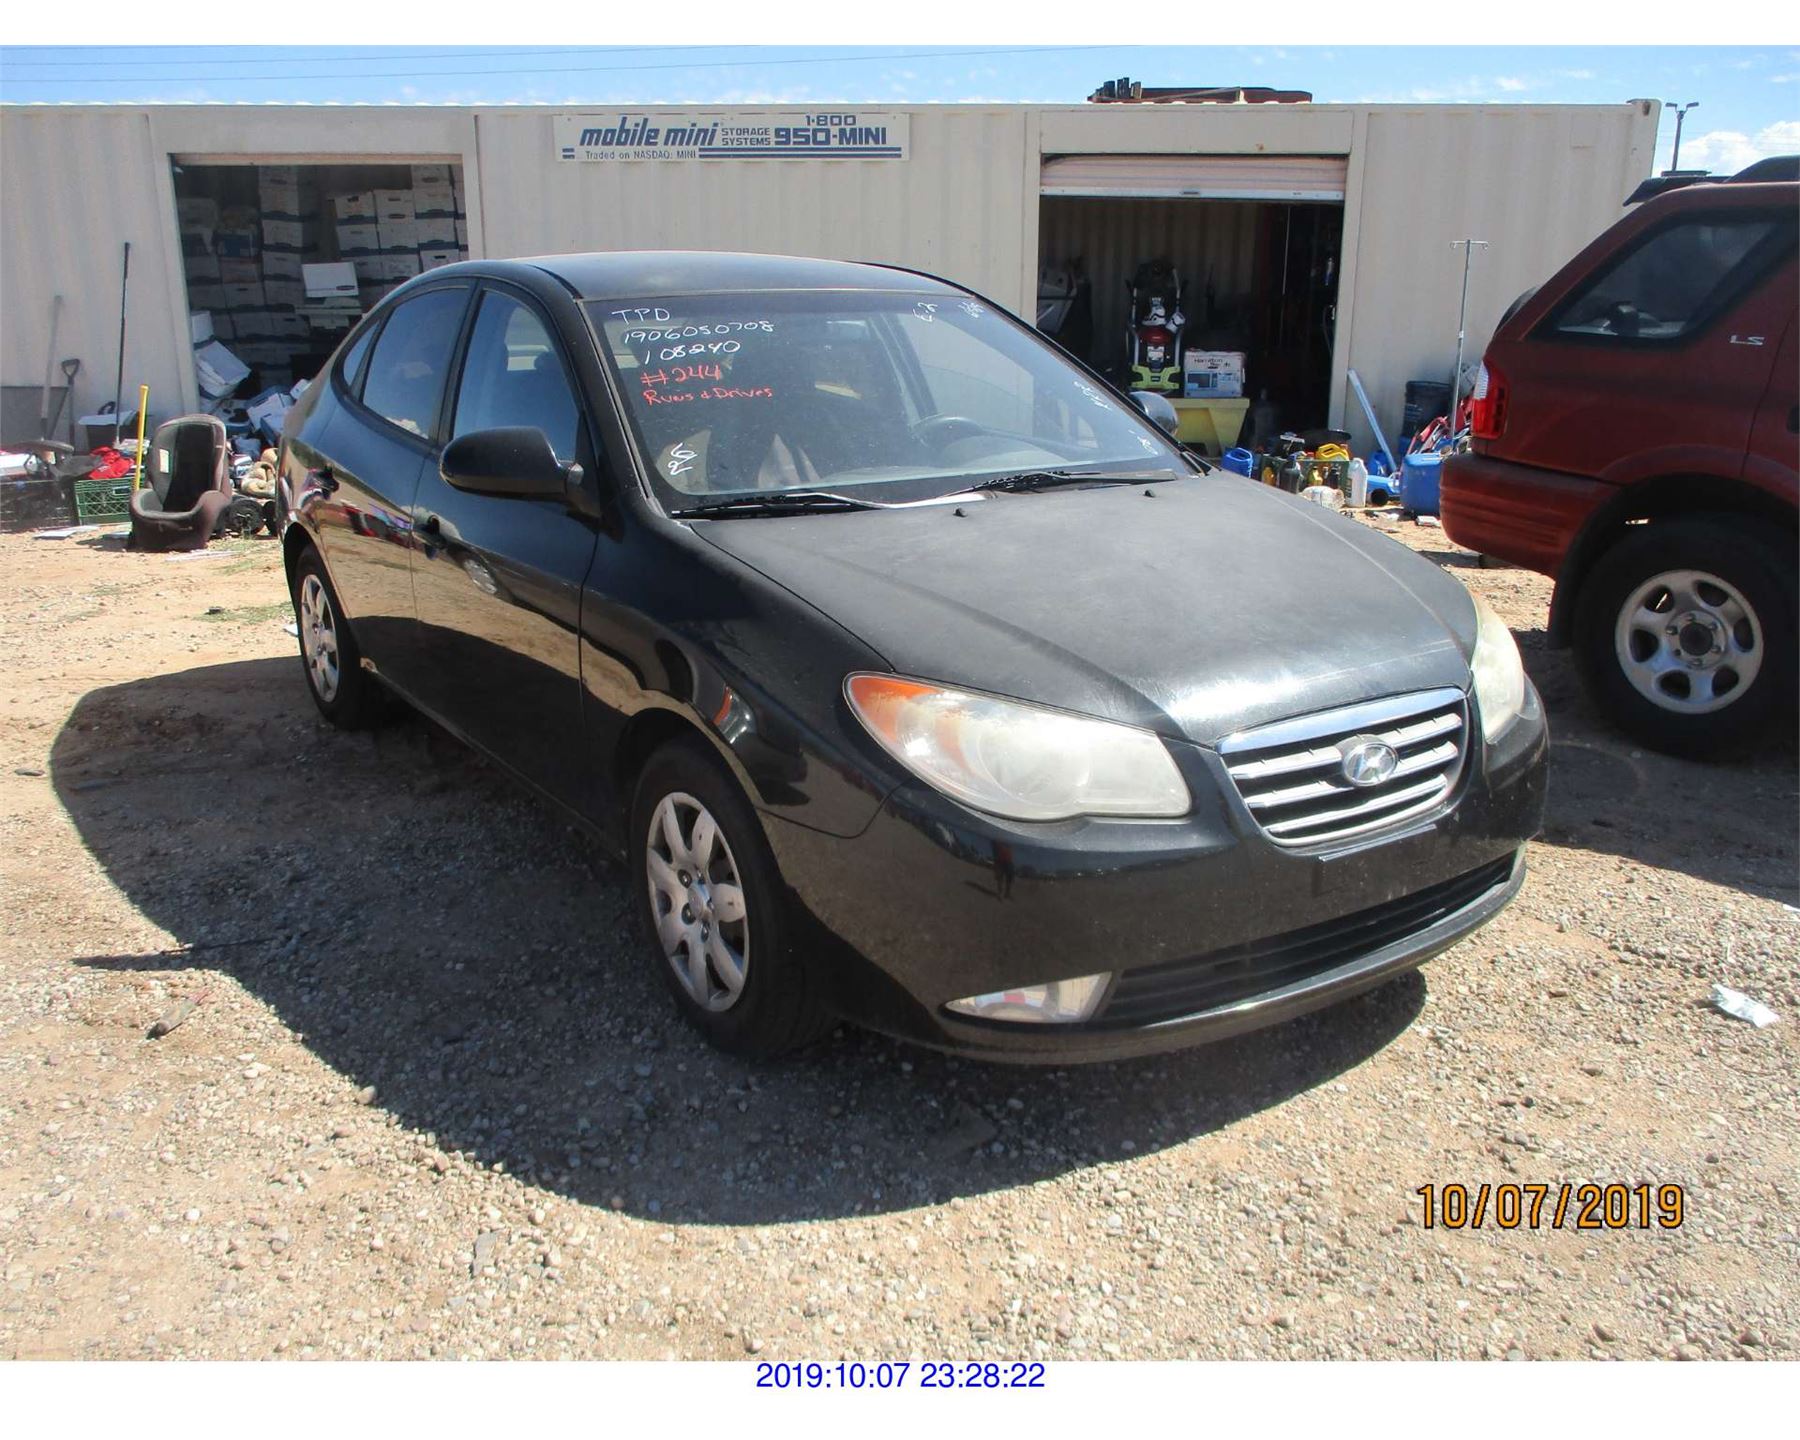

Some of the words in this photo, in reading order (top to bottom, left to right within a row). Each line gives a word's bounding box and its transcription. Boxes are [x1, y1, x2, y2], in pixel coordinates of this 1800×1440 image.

[579, 116, 660, 146] mobile
[663, 122, 719, 146] mini
[721, 128, 771, 136] STORAGE
[774, 127, 887, 146] 950-MINI
[721, 137, 772, 146] SYSTEMS
[586, 150, 615, 160] Traded
[619, 152, 630, 160] on
[633, 150, 673, 160] NASDAQ:
[676, 150, 697, 160] MINI
[612, 308, 671, 325] TPD
[1730, 335, 1765, 346] LS
